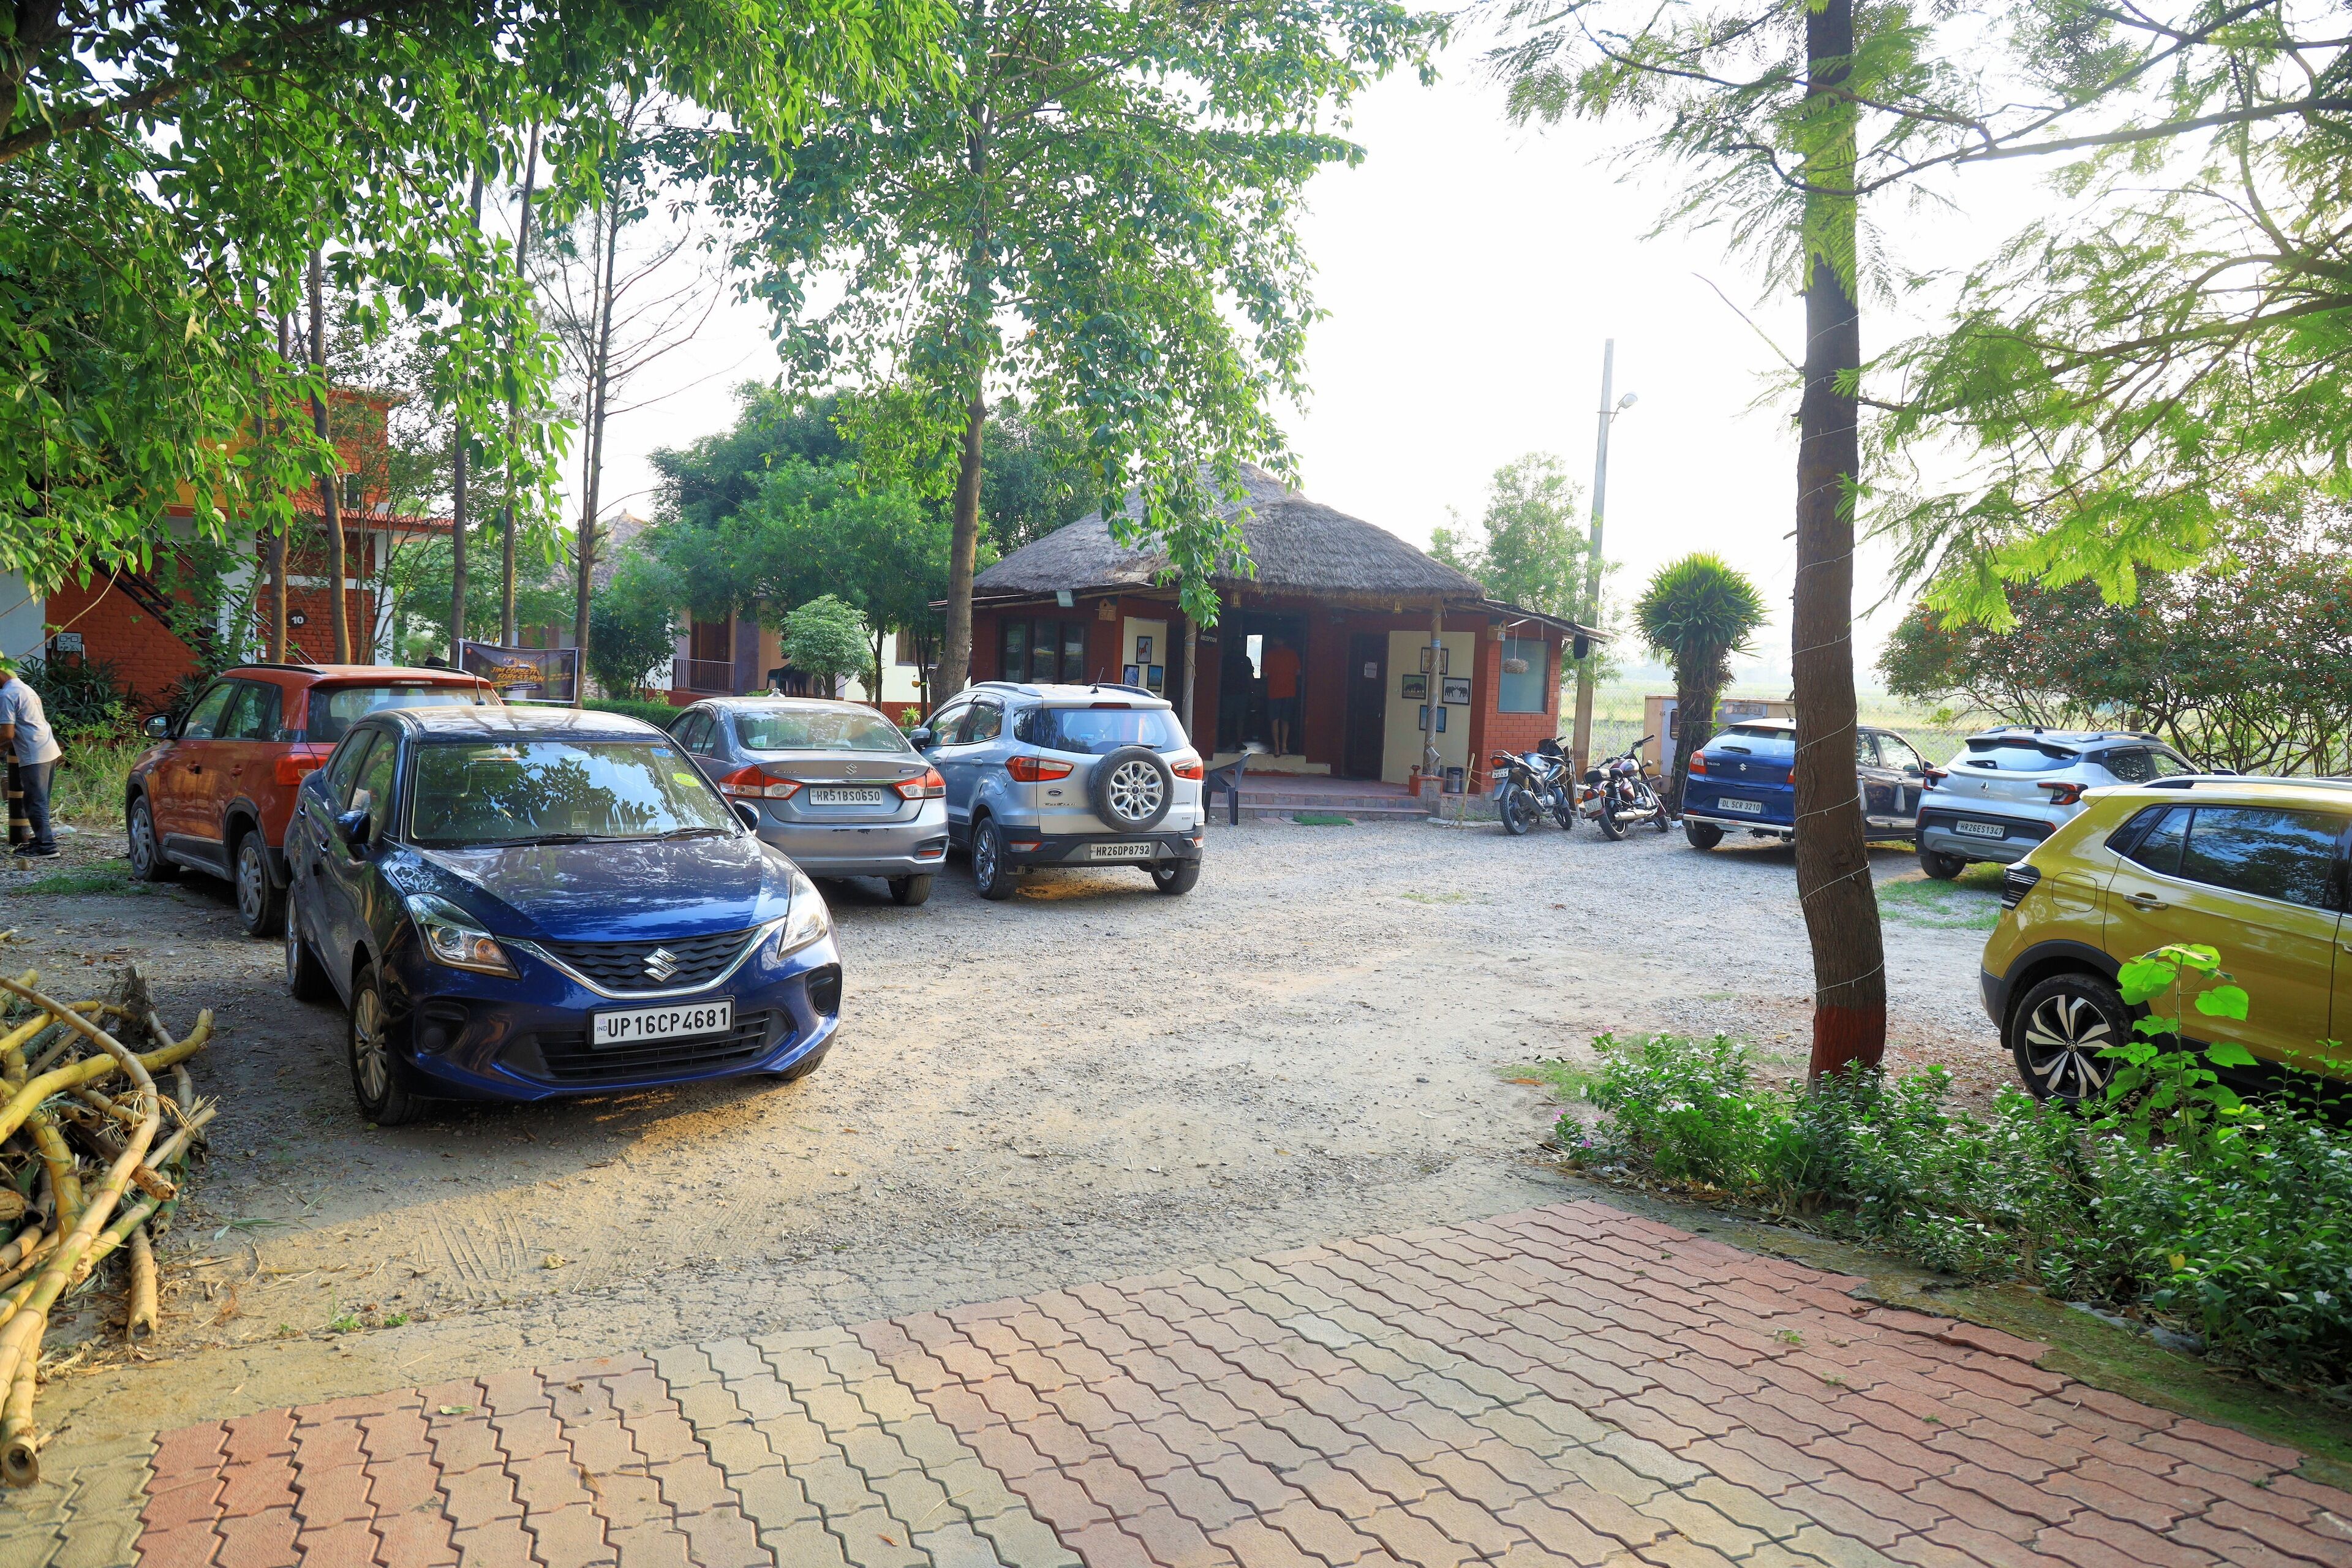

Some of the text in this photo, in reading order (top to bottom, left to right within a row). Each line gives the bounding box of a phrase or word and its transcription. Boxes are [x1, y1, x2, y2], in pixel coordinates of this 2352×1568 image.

[291, 616, 304, 624] 10
[816, 790, 880, 802] HR51BS0650
[1744, 802, 1760, 811] 3210
[1960, 823, 2003, 835] HR26ES1347
[1096, 845, 1150, 856] HR26DP8792
